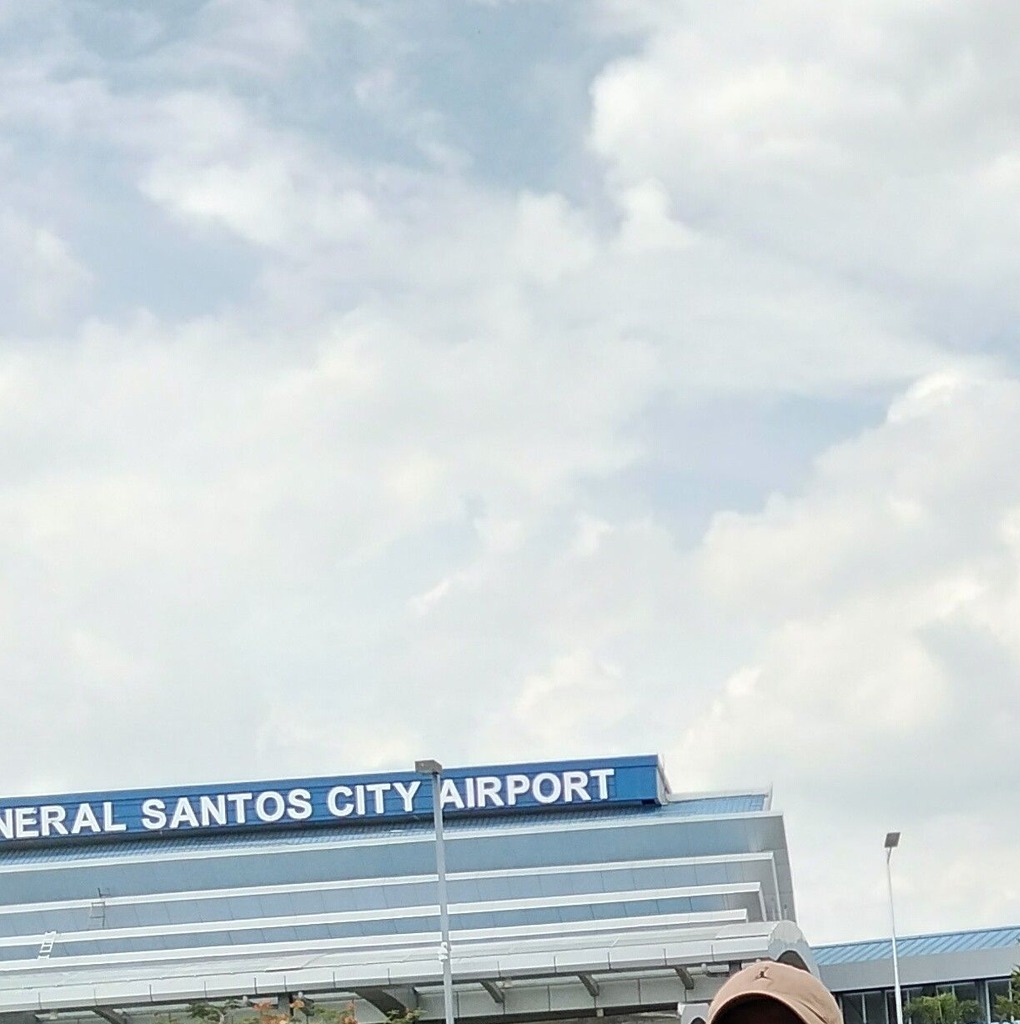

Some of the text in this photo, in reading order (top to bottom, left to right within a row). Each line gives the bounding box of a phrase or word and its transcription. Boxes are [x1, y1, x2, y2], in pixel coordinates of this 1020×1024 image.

[141, 788, 312, 830] SANTOS
[327, 781, 421, 817] CITY
[439, 768, 615, 810] AIRPORT
